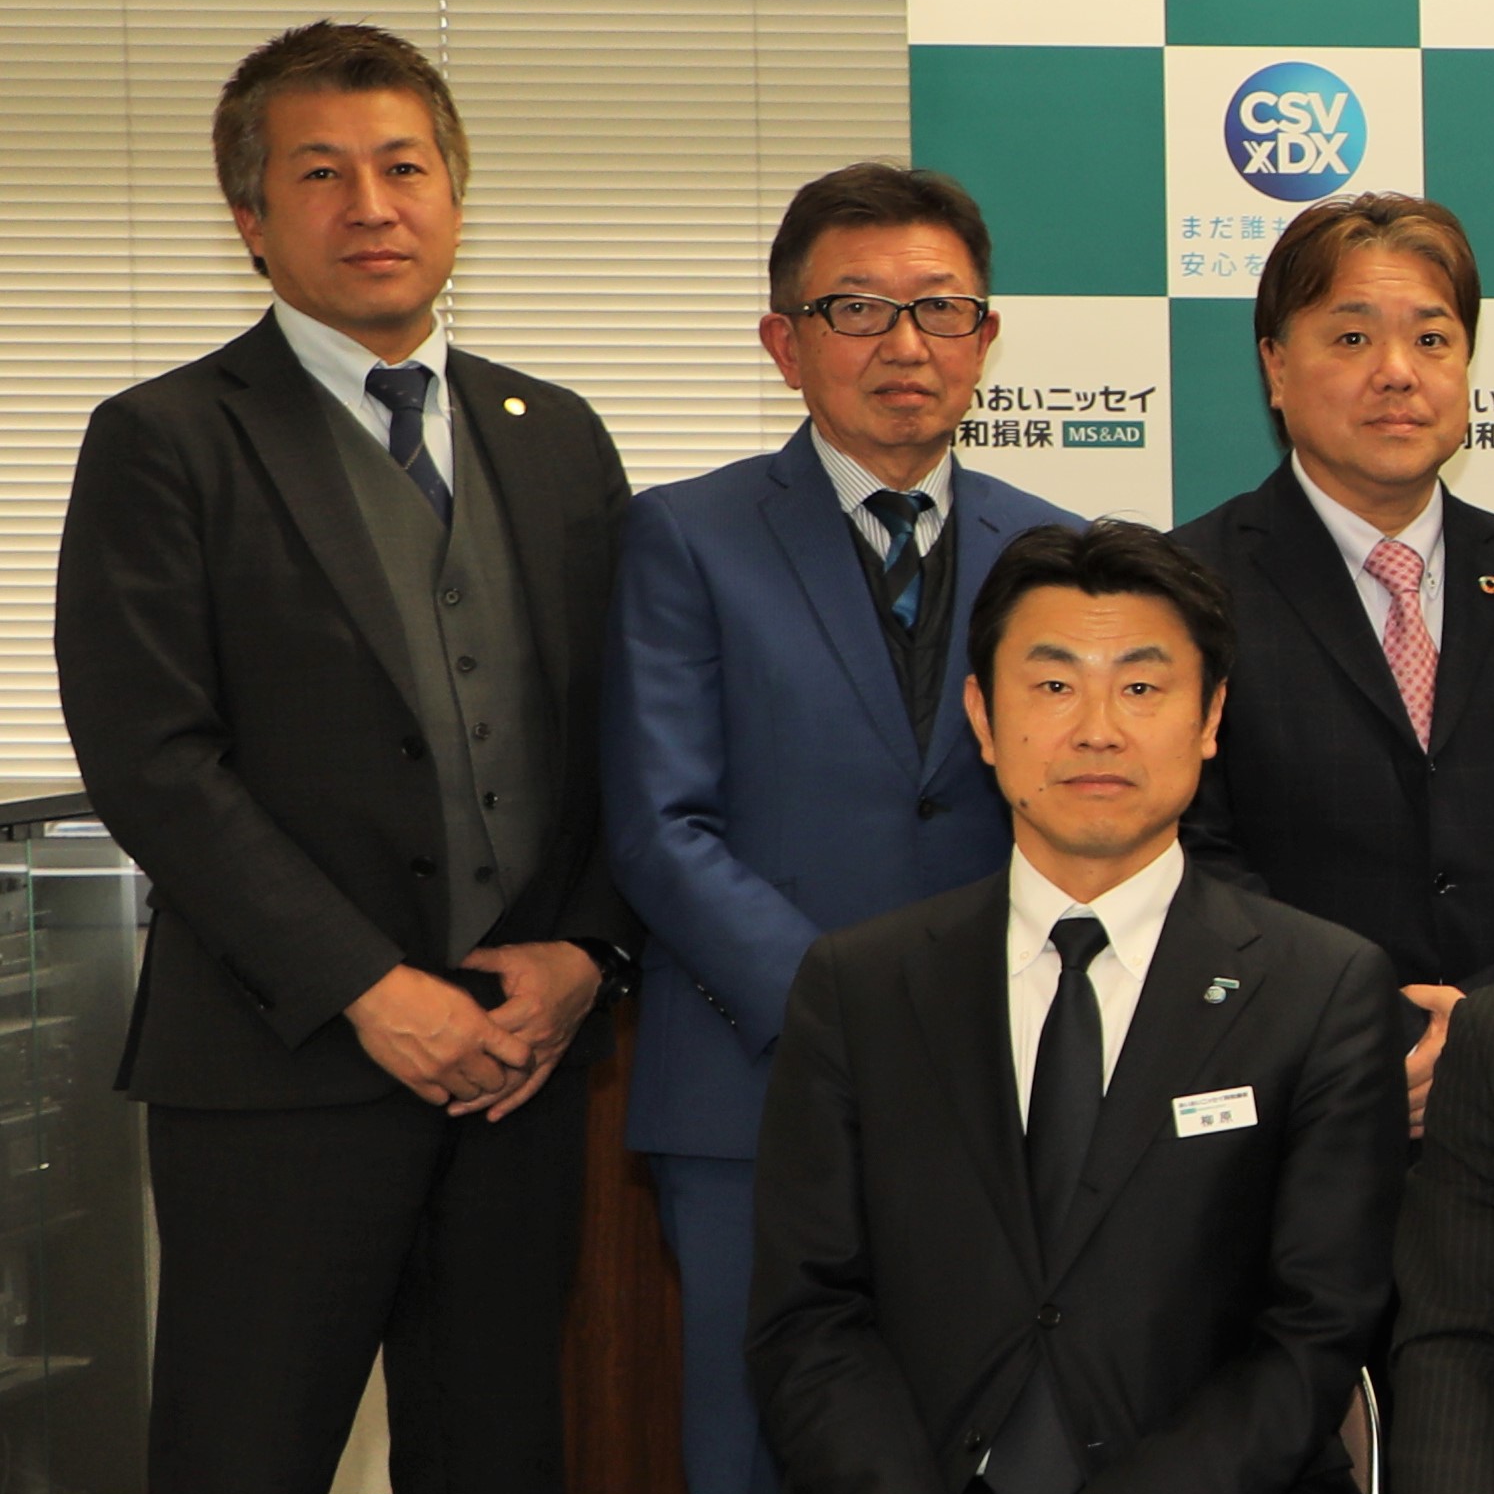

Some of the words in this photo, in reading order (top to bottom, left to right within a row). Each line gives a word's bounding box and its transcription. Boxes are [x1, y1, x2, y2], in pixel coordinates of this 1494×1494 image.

[1239, 90, 1349, 135] CSV
[950, 419, 1054, 448] 和損保
[1066, 425, 1142, 444] MS&AD
